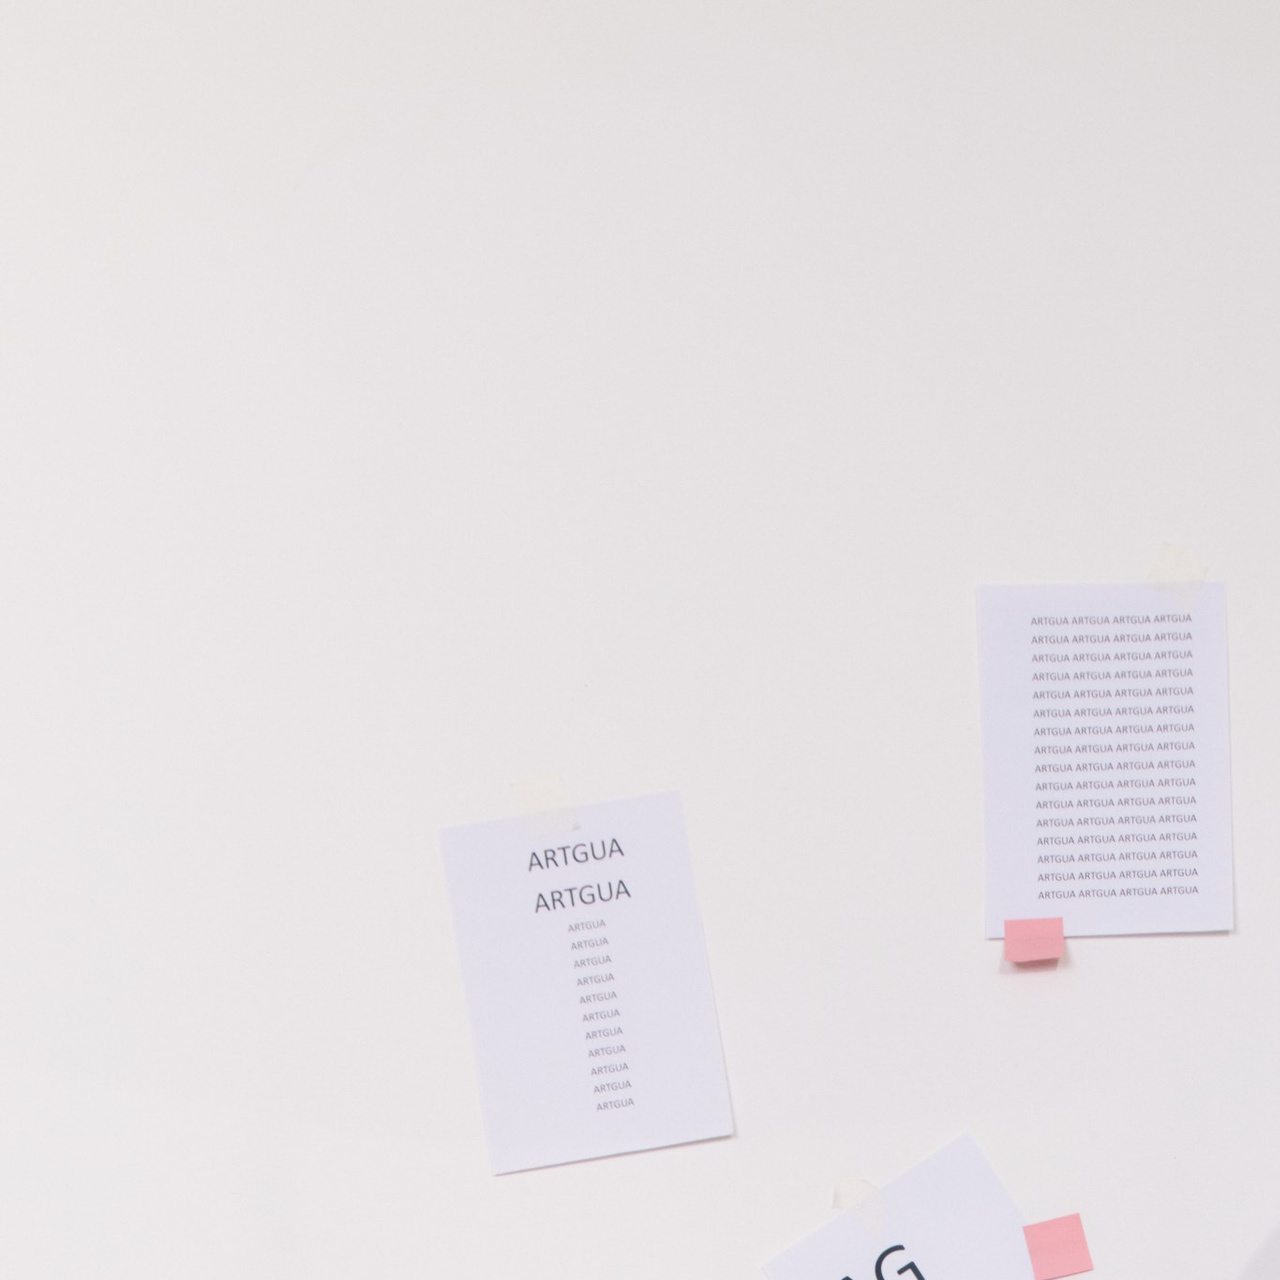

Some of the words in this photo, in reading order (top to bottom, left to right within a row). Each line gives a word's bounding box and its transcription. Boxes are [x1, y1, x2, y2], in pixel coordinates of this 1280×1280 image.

[1031, 617, 1069, 626] ARTGUA
[1071, 616, 1110, 625] ARTGUA
[1112, 615, 1151, 625] ARTGUA
[1153, 614, 1192, 623] ARTGUA
[1031, 635, 1069, 645] ARTGUA
[1072, 634, 1111, 644] ARTGUA
[1113, 634, 1151, 643] ARTGUA
[1154, 632, 1192, 642] ARTGUA
[1032, 653, 1070, 663] ARTGUA
[1072, 653, 1111, 662] ARTGUA
[1113, 652, 1152, 662] ARTGUA
[1154, 650, 1193, 660] ARTGUA
[1032, 672, 1070, 681] ARTGUA
[1073, 671, 1112, 681] ARTGUA
[1114, 670, 1152, 680] ARTGUA
[1155, 668, 1193, 678] ARTGUA
[1032, 690, 1071, 700] ARTGUA
[1073, 689, 1112, 699] ARTGUA
[1114, 688, 1153, 698] ARTGUA
[1155, 686, 1194, 696] ARTGUA
[1033, 709, 1072, 718] ARTGUA
[1074, 707, 1113, 718] ARTGUA
[1115, 706, 1153, 716] ARTGUA
[1155, 705, 1194, 715] ARTGUA
[1034, 726, 1072, 736] ARTGUA
[1074, 725, 1113, 735] ARTGUA
[1115, 724, 1154, 734] ARTGUA
[1156, 723, 1195, 733] ARTGUA
[1034, 745, 1073, 756] ARTGUA
[1075, 744, 1113, 754] ARTGUA
[1115, 743, 1154, 753] ARTGUA
[1157, 741, 1195, 751] ARTGUA
[1035, 763, 1073, 773] ARTGUA
[1075, 762, 1114, 772] ARTGUA
[1116, 760, 1155, 771] ARTGUA
[1157, 760, 1196, 771] ARTGUA
[1035, 781, 1074, 791] ARTGUA
[1076, 780, 1114, 790] ARTGUA
[1116, 779, 1155, 788] ARTGUA
[1157, 777, 1196, 787] ARTGUA
[1036, 800, 1074, 809] ARTGUA
[1076, 798, 1115, 809] ARTGUA
[1117, 797, 1156, 807] ARTGUA
[1158, 796, 1197, 805] ARTGUA
[1036, 817, 1074, 828] ARTGUA
[1076, 816, 1115, 826] ARTGUA
[1117, 815, 1156, 825] ARTGUA
[1158, 814, 1197, 824] ARTGUA
[1037, 836, 1075, 846] ARTGUA
[1077, 834, 1116, 844] ARTGUA
[1118, 833, 1157, 843] ARTGUA
[1159, 832, 1198, 842] ARTGUA
[528, 838, 624, 872] ARTGUA
[1037, 854, 1075, 864] ARTGUA
[1077, 853, 1116, 862] ARTGUA
[1118, 850, 1158, 861] ARTGUA
[1159, 850, 1198, 860] ARTGUA
[1038, 872, 1076, 883] ARTGUA
[1078, 871, 1117, 881] ARTGUA
[1119, 869, 1157, 879] ARTGUA
[1160, 868, 1198, 878] ARTGUA
[535, 880, 631, 913] ARTGUA
[1038, 890, 1076, 899] ARTGUA
[1078, 889, 1117, 898] ARTGUA
[1119, 885, 1158, 897] ARTGUA
[1160, 886, 1199, 896] ARTGUA
[568, 919, 606, 933] ARTGUA
[571, 937, 609, 951] ARTGUA
[574, 955, 612, 969] ARTGUA
[577, 973, 615, 986] ARTGUA
[579, 991, 618, 1004] ARTGUA
[582, 1008, 621, 1023] ARTGUA
[585, 1026, 623, 1040] ARTGUA
[588, 1044, 626, 1058] ARTGUA
[591, 1062, 629, 1076] ARTGUA
[594, 1080, 632, 1094] ARTGUA
[596, 1097, 635, 1112] ARTGUA
